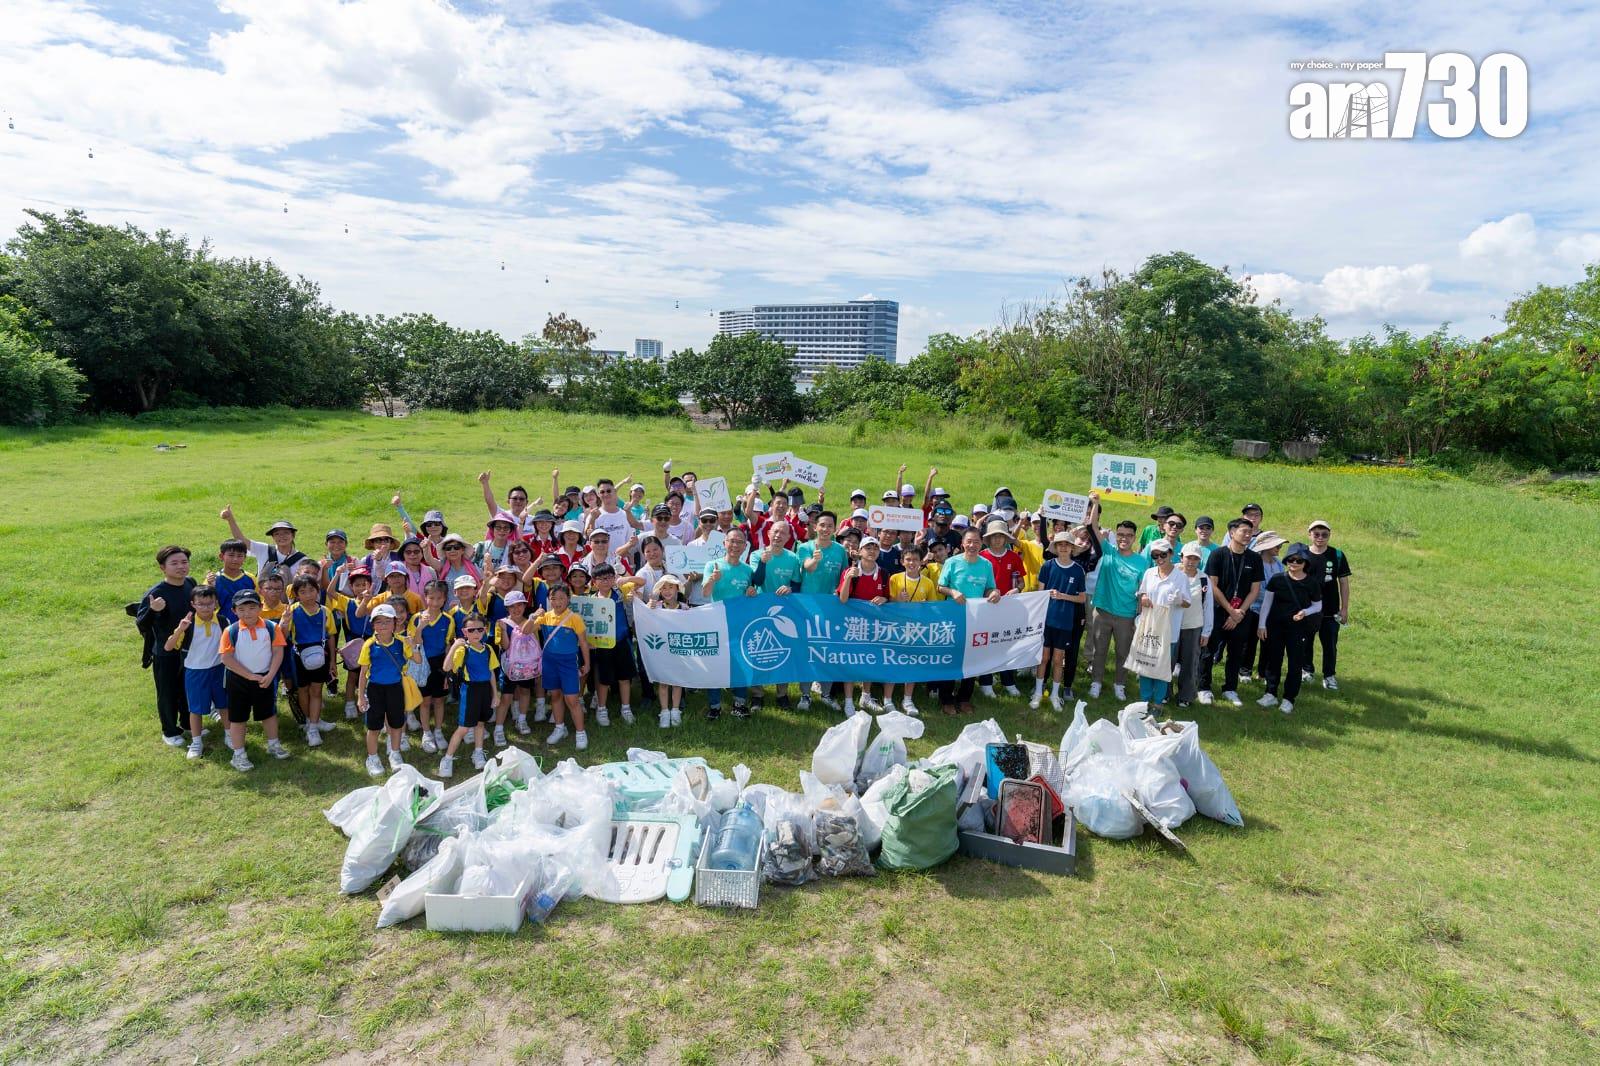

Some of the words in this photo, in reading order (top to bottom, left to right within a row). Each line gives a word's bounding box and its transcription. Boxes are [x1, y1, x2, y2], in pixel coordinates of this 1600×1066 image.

[1110, 460, 1136, 475] 聯同
[1096, 474, 1149, 493] 綠色伙伴
[669, 633, 718, 647] 綠色力量
[669, 648, 692, 656] GREEN
[807, 646, 877, 665] Nature
[882, 648, 953, 665] Rescue
